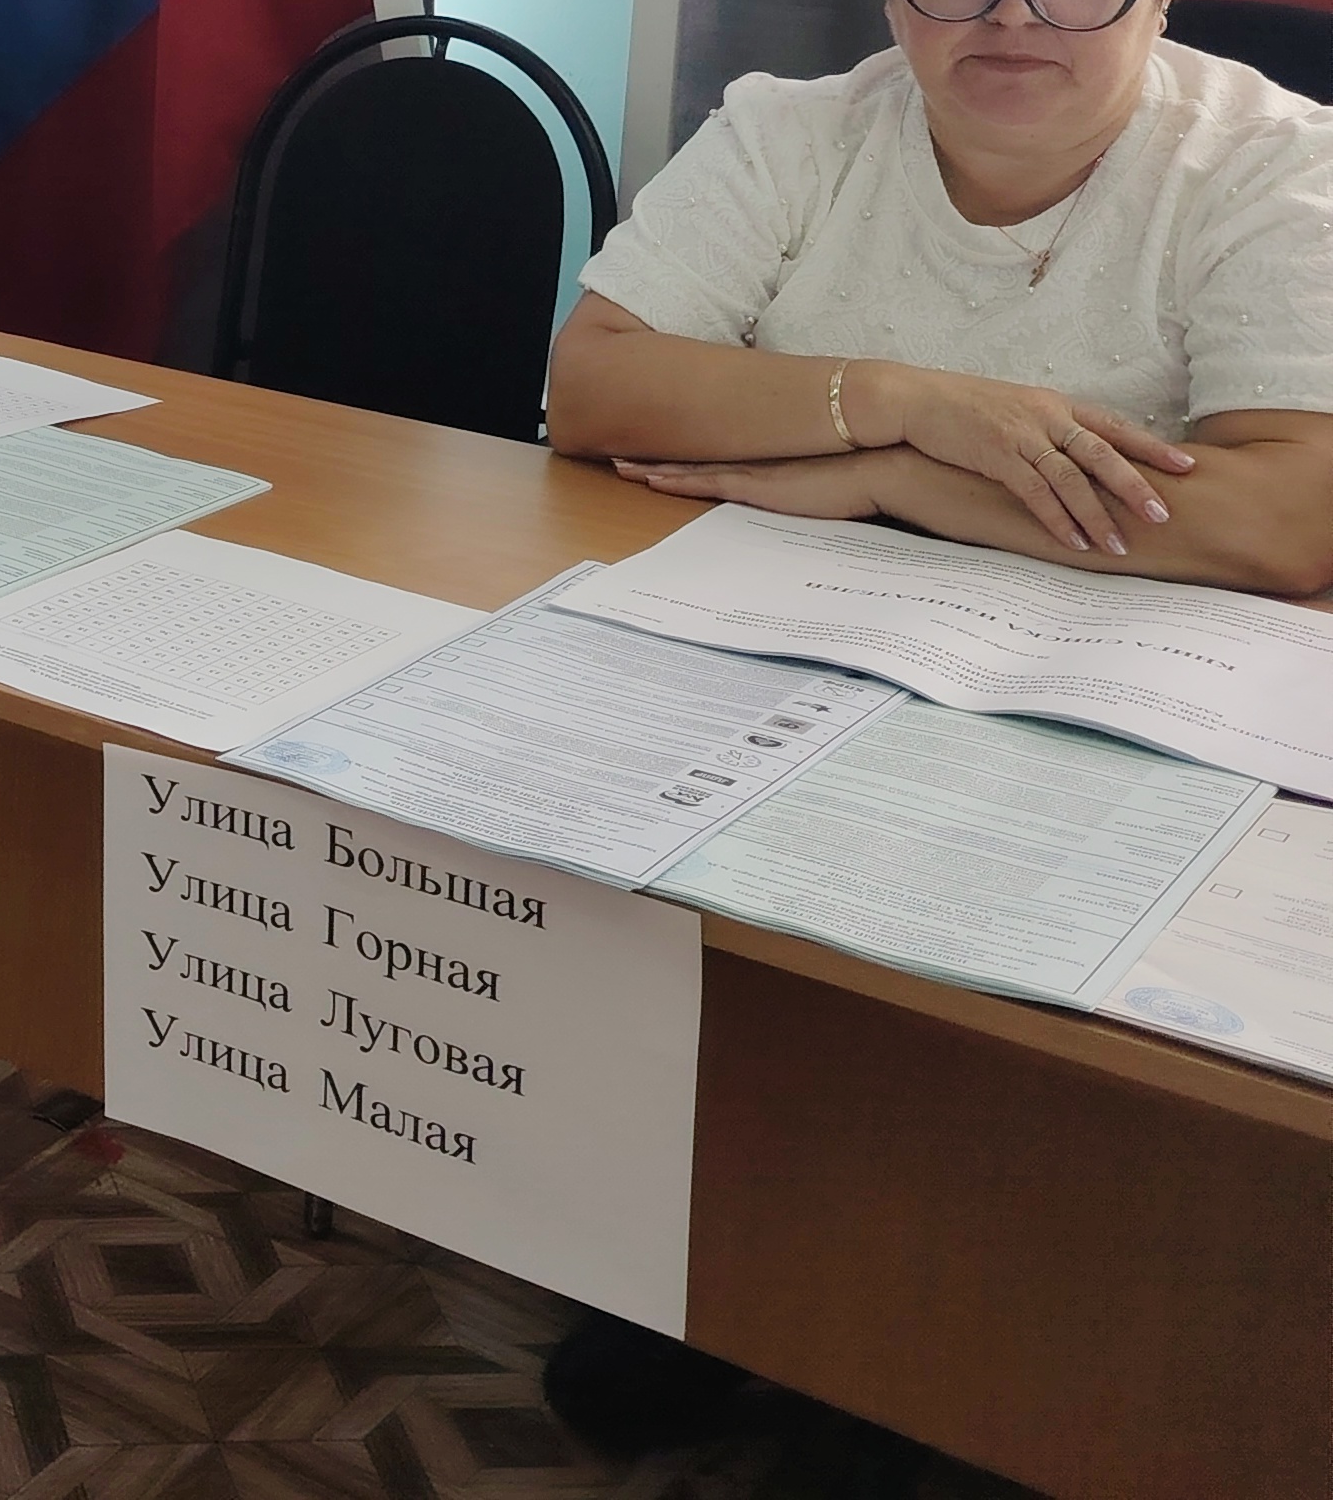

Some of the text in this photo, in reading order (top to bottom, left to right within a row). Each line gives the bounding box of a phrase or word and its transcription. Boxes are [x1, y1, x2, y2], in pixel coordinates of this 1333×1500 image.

[805, 582, 1236, 672] КНИГА СПИСКА ИЗБИРАТЕЛЕЙ
[141, 773, 548, 930] Улица Большая
[141, 852, 502, 1002] Улица Горная
[141, 929, 526, 1097] Улица Луговая
[141, 1007, 478, 1165] Улица Малая
